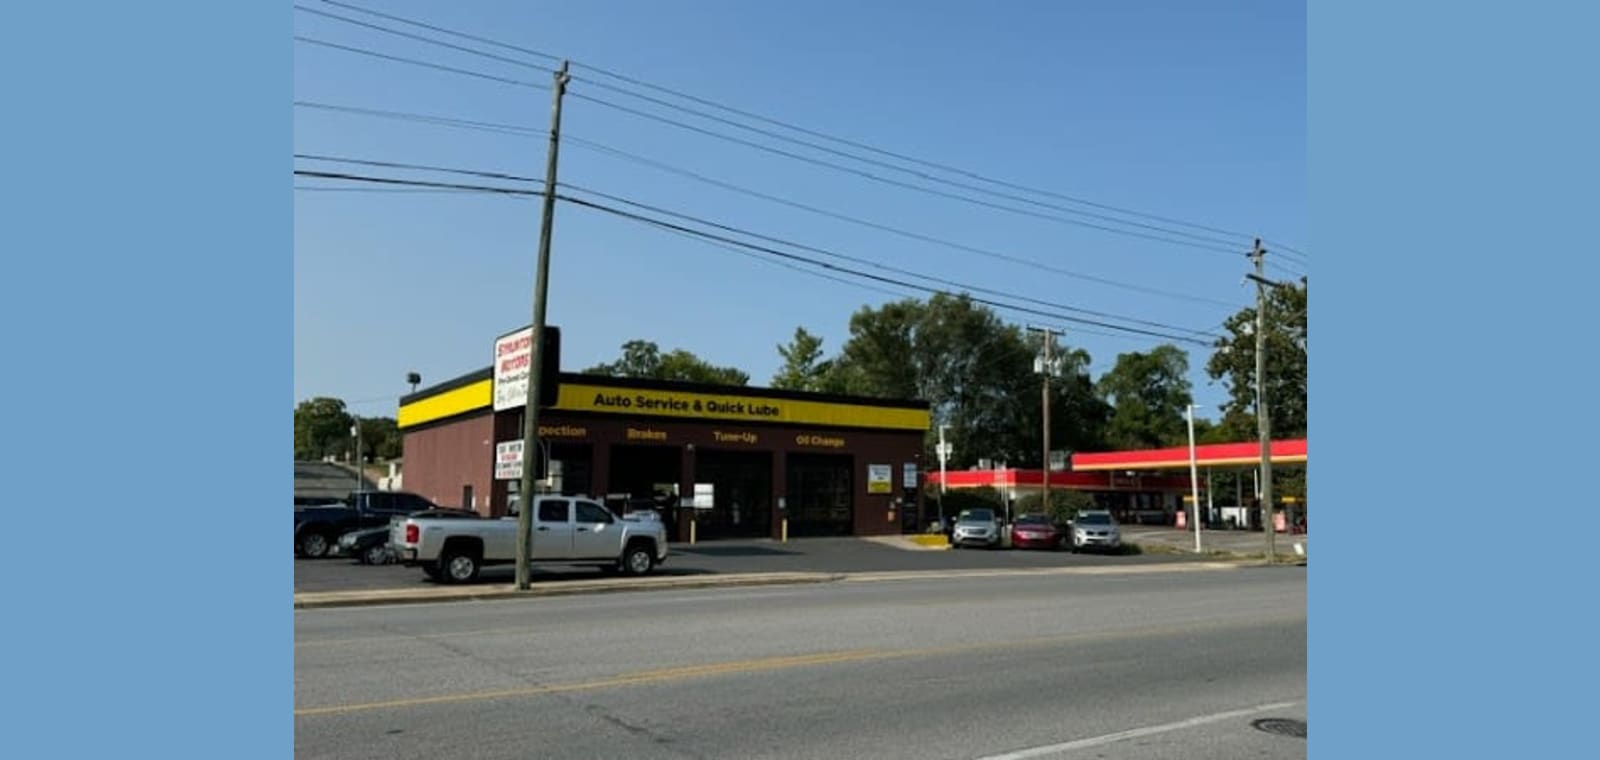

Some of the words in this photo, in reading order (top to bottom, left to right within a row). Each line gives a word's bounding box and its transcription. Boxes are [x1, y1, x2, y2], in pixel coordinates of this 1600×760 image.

[593, 392, 632, 408] Auto
[635, 395, 689, 411] Service
[693, 399, 703, 412] &
[706, 400, 745, 415] Quick
[747, 403, 780, 417] Lube
[538, 426, 586, 438] pection
[627, 428, 667, 440] Brakes
[713, 431, 758, 444] Tune-Up
[795, 434, 809, 446] Oil
[810, 435, 846, 448] Change
